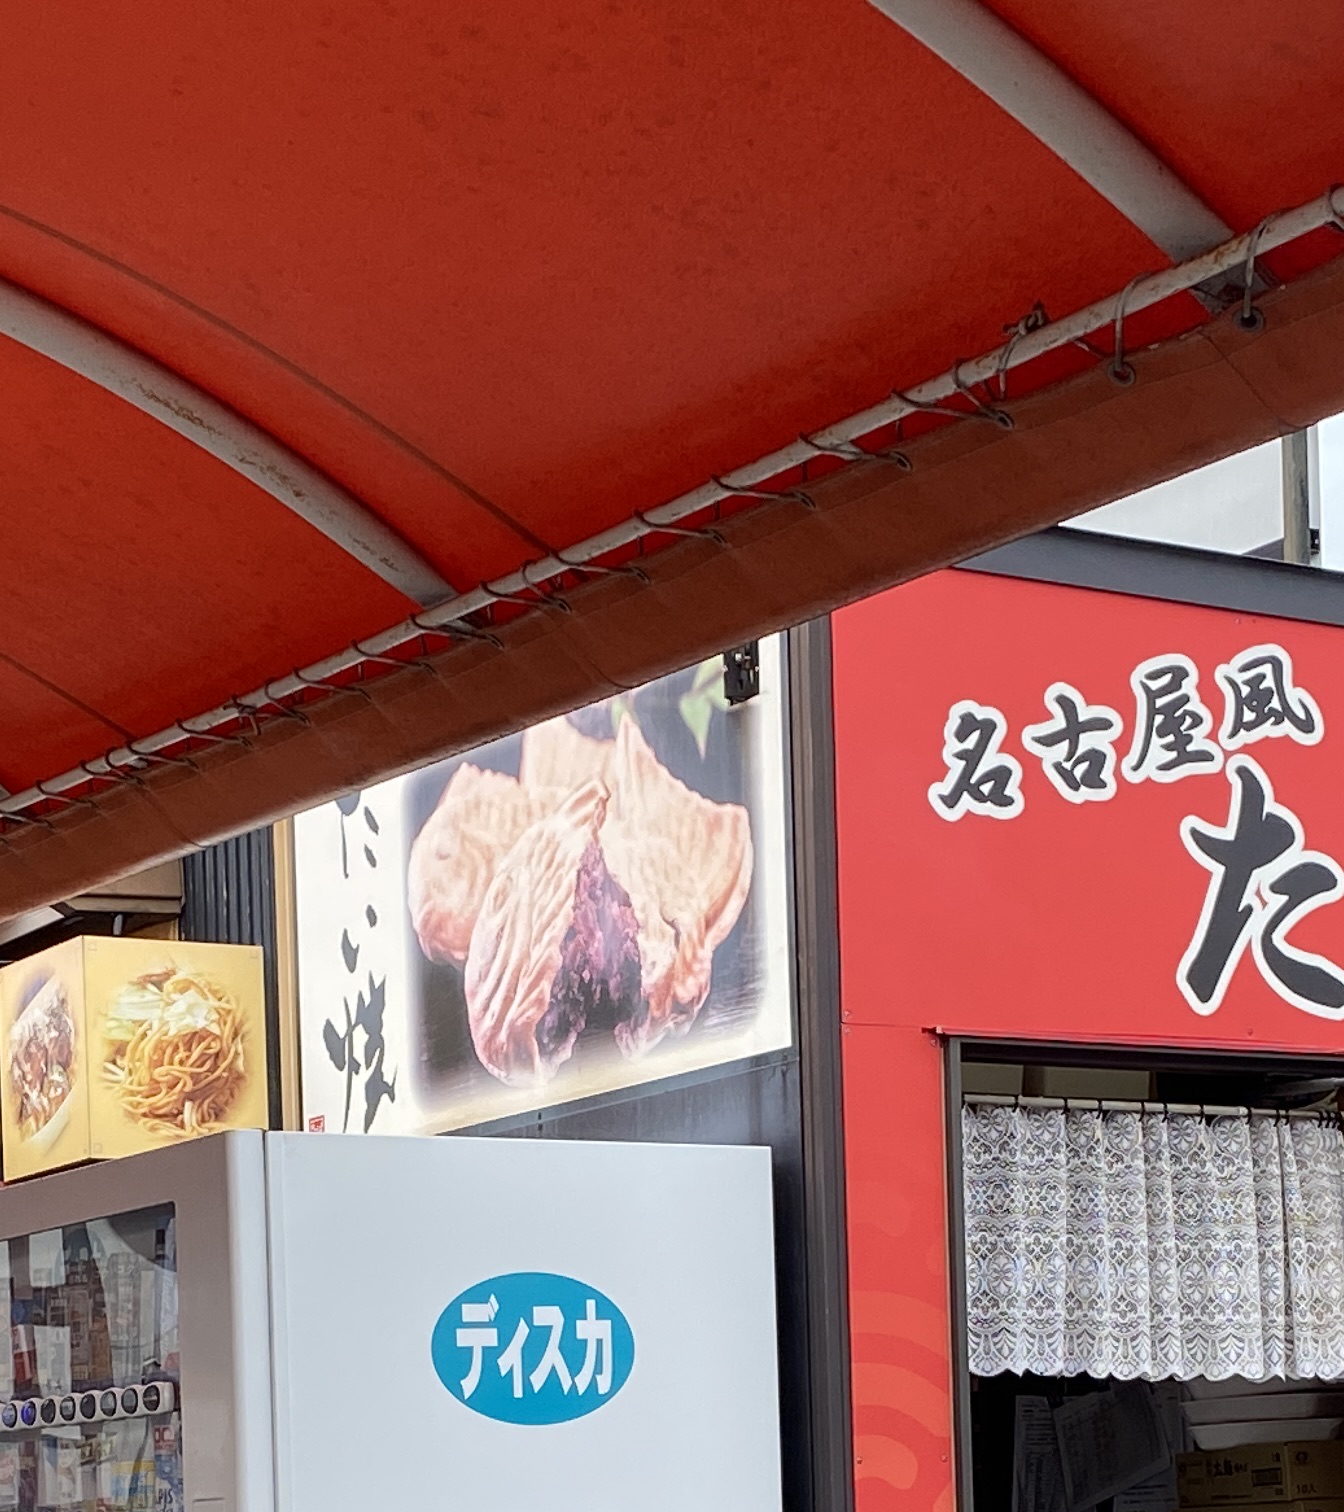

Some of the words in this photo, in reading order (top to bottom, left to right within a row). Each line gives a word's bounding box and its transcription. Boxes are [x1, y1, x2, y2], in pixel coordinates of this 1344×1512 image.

[932, 648, 1320, 817] 名古屋風
[455, 1292, 612, 1399] ディスカ
